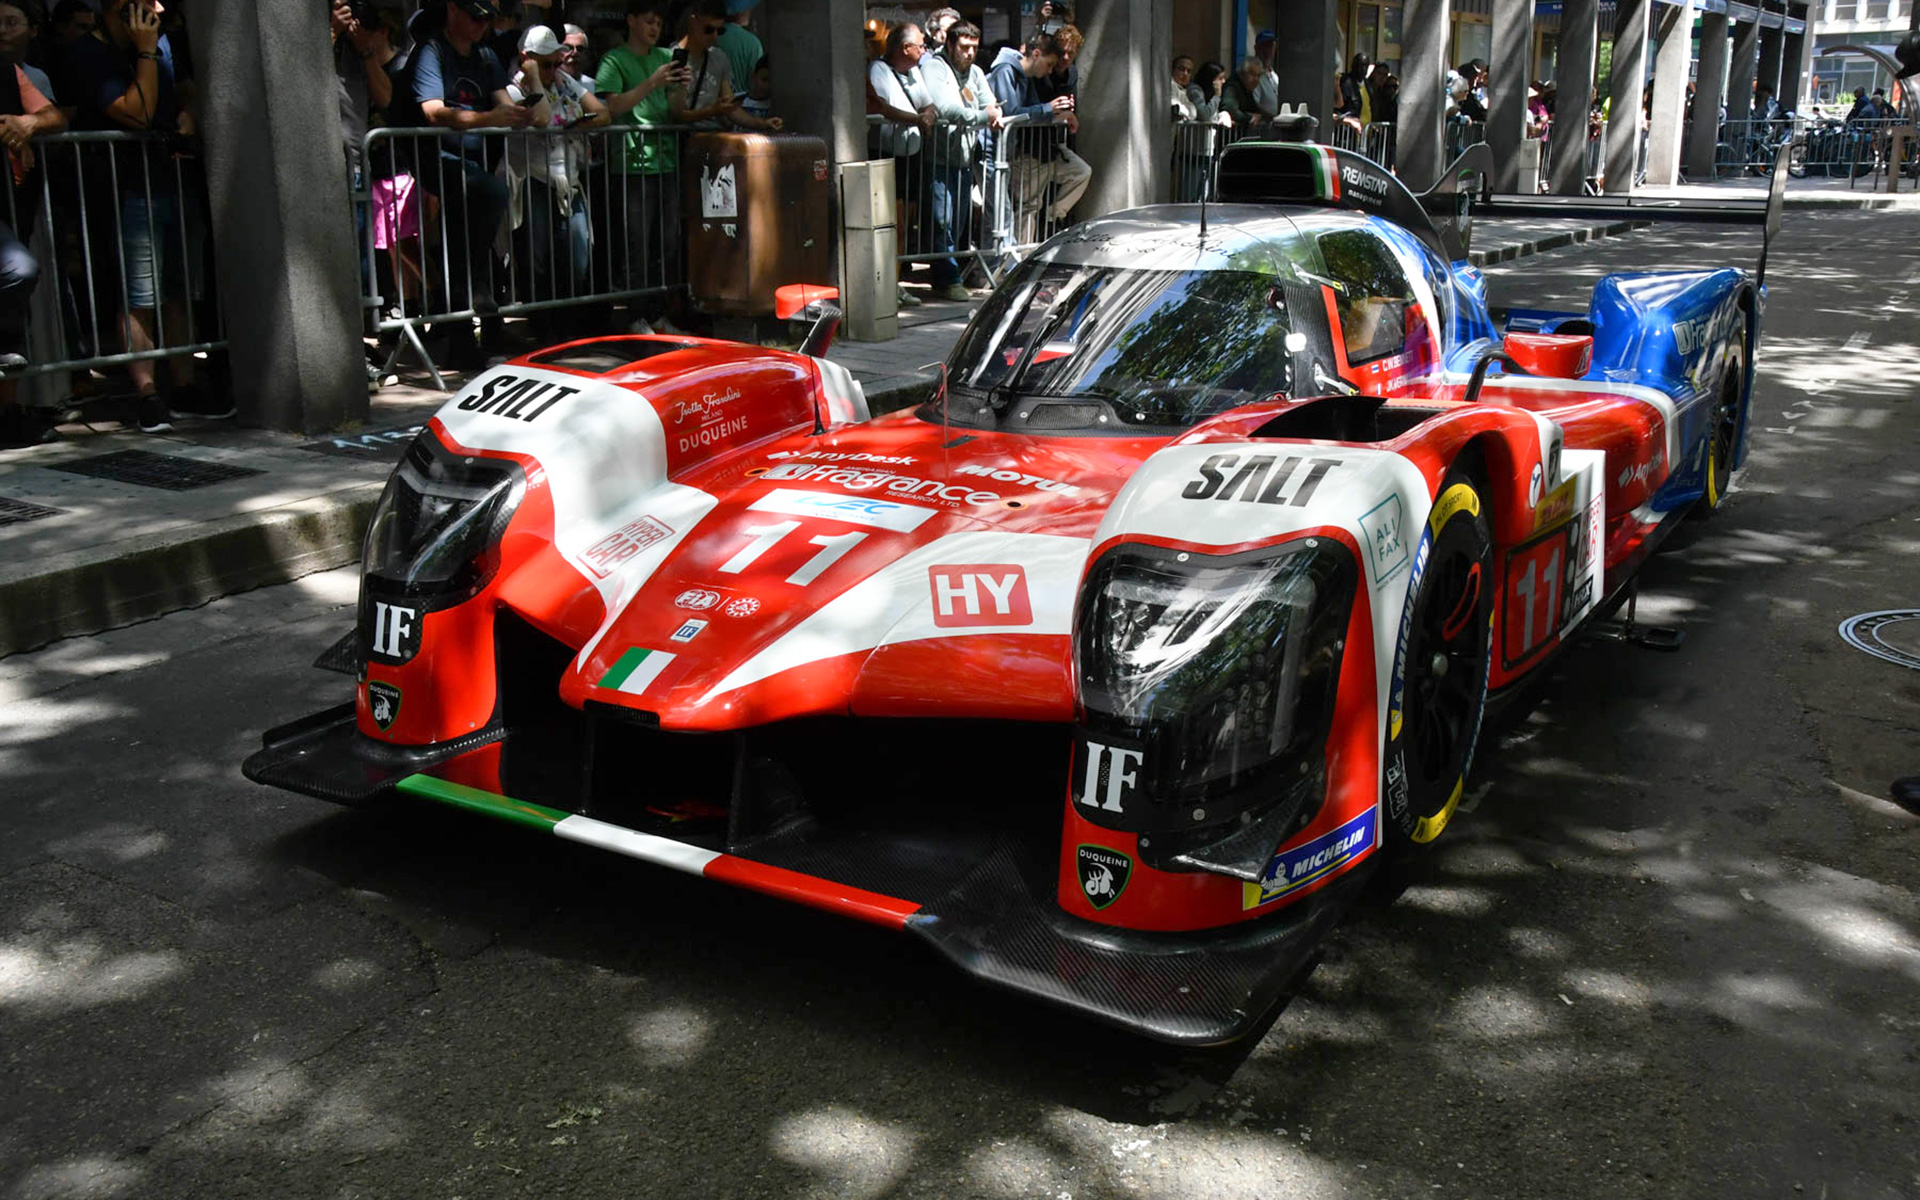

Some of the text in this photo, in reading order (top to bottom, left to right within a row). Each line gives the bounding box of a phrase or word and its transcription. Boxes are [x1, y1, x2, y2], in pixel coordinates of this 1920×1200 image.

[1342, 166, 1388, 196] REMSTAR
[457, 375, 581, 423] SALT
[680, 416, 748, 453] DUQUEINE
[801, 450, 919, 467] AnyDesk
[798, 464, 1000, 507] Fragrance
[884, 490, 960, 508] RESEARCH LTD
[955, 465, 1081, 497] MOTUL
[1181, 454, 1343, 508] SALT
[585, 532, 640, 567] CAR
[1376, 517, 1396, 543] ALI
[1379, 537, 1401, 562] FAX
[718, 519, 870, 587] 11
[678, 590, 717, 608] FIA
[935, 573, 1019, 616] HY
[1396, 537, 1430, 681] MICHELIN
[1516, 547, 1560, 652] 11
[372, 601, 416, 658] IF
[1080, 741, 1144, 813] IF
[1079, 848, 1128, 868] DUQUEINE
[1291, 826, 1366, 878] MICHELIN
